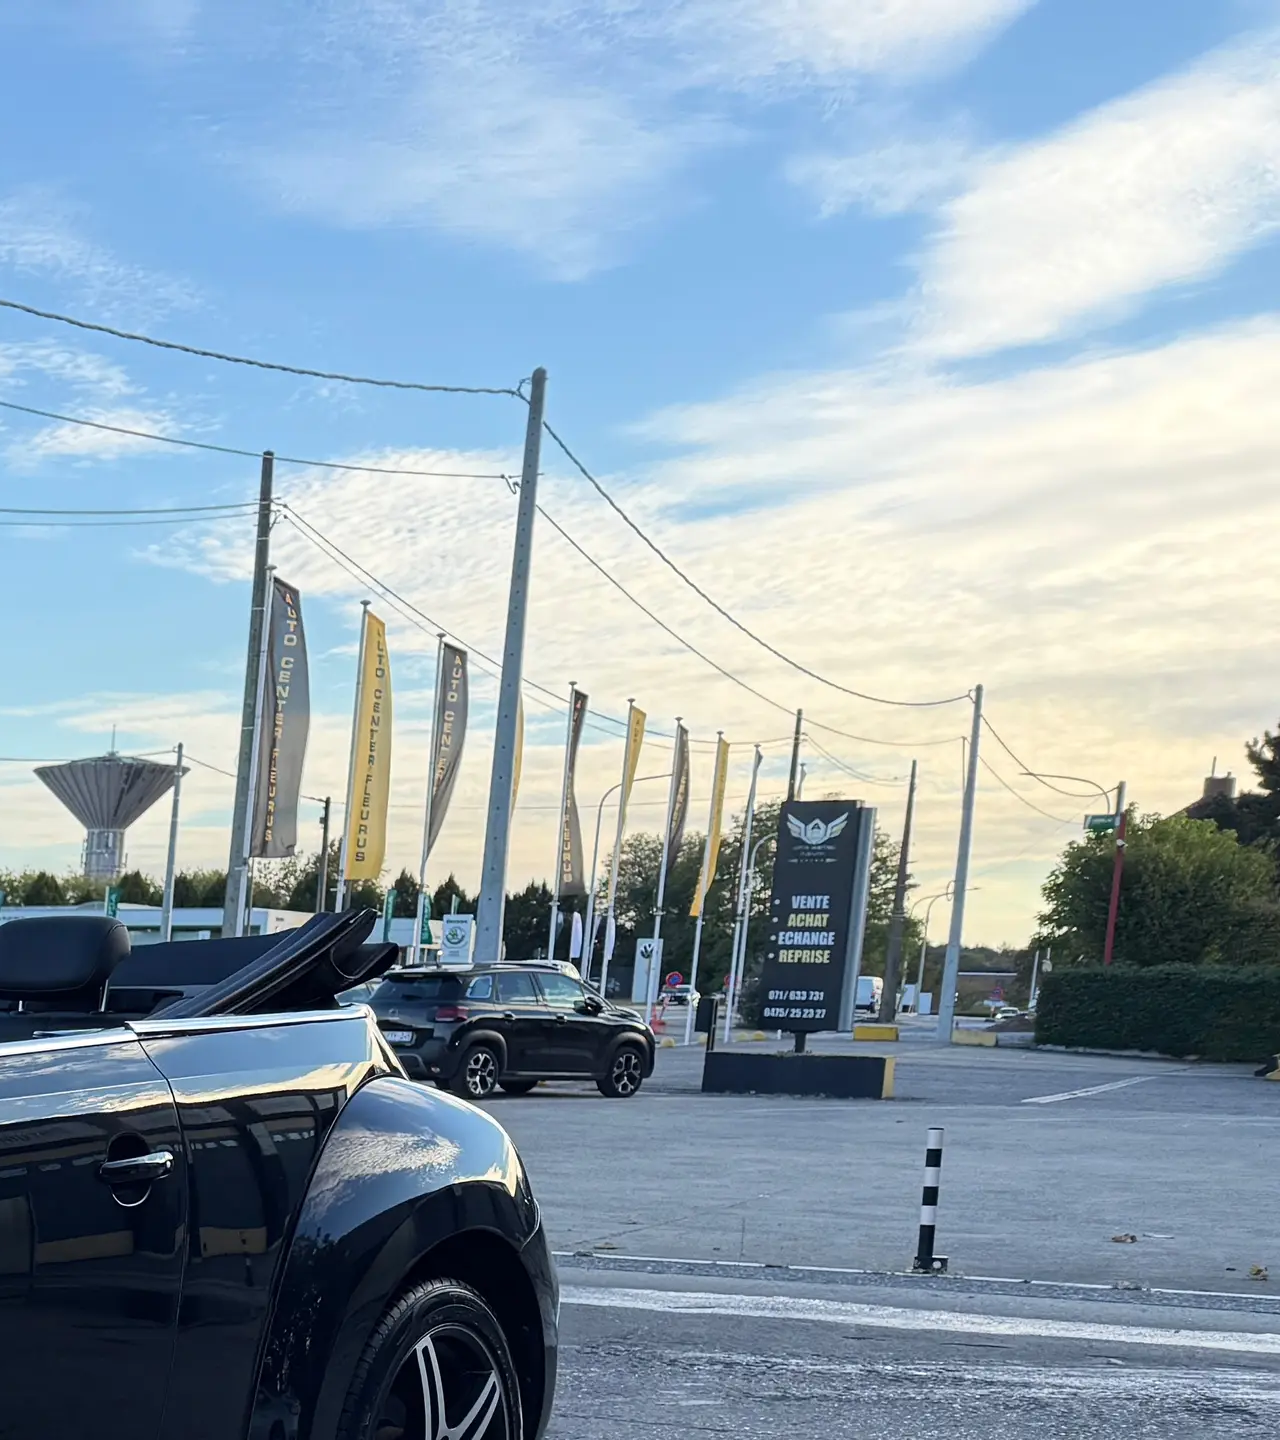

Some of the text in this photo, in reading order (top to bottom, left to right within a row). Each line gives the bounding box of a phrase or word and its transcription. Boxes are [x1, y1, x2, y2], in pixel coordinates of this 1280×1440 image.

[447, 655, 463, 702] AUTO
[355, 775, 373, 862] FLEURUS
[791, 895, 830, 909] VENTE
[787, 913, 830, 927] ACHAT
[777, 931, 836, 946] ECHANGE
[778, 949, 831, 963] REPRISE
